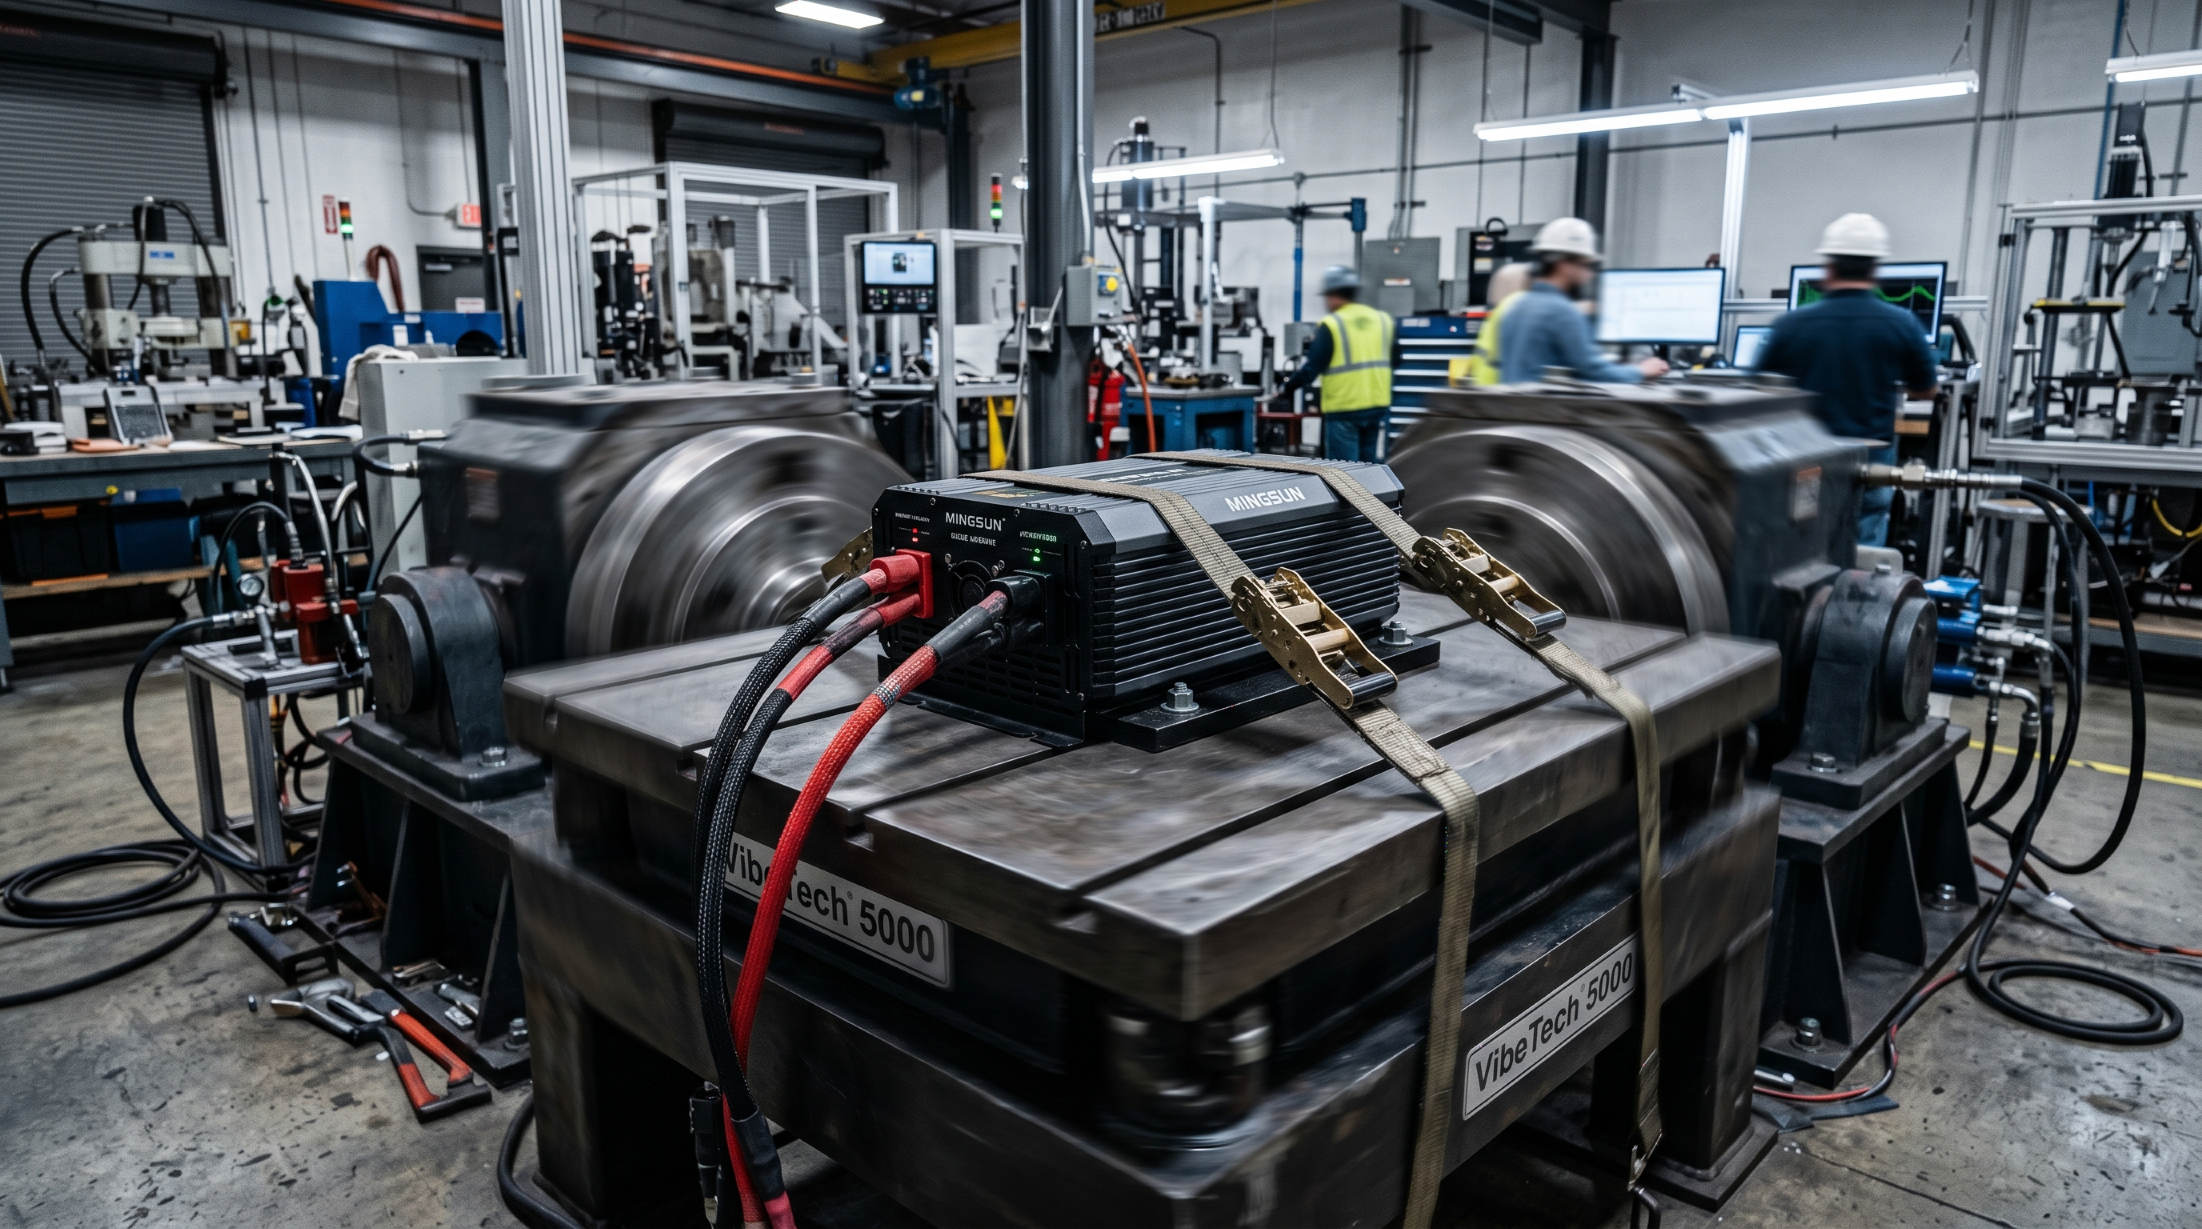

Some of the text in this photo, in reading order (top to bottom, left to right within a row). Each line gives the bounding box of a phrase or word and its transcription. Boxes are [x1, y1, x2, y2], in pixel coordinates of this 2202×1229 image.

[1224, 486, 1306, 512] MINGSUN
[945, 511, 1002, 532] MINGSUN
[859, 899, 935, 963] 5000
[1586, 952, 1633, 1011] 5000
